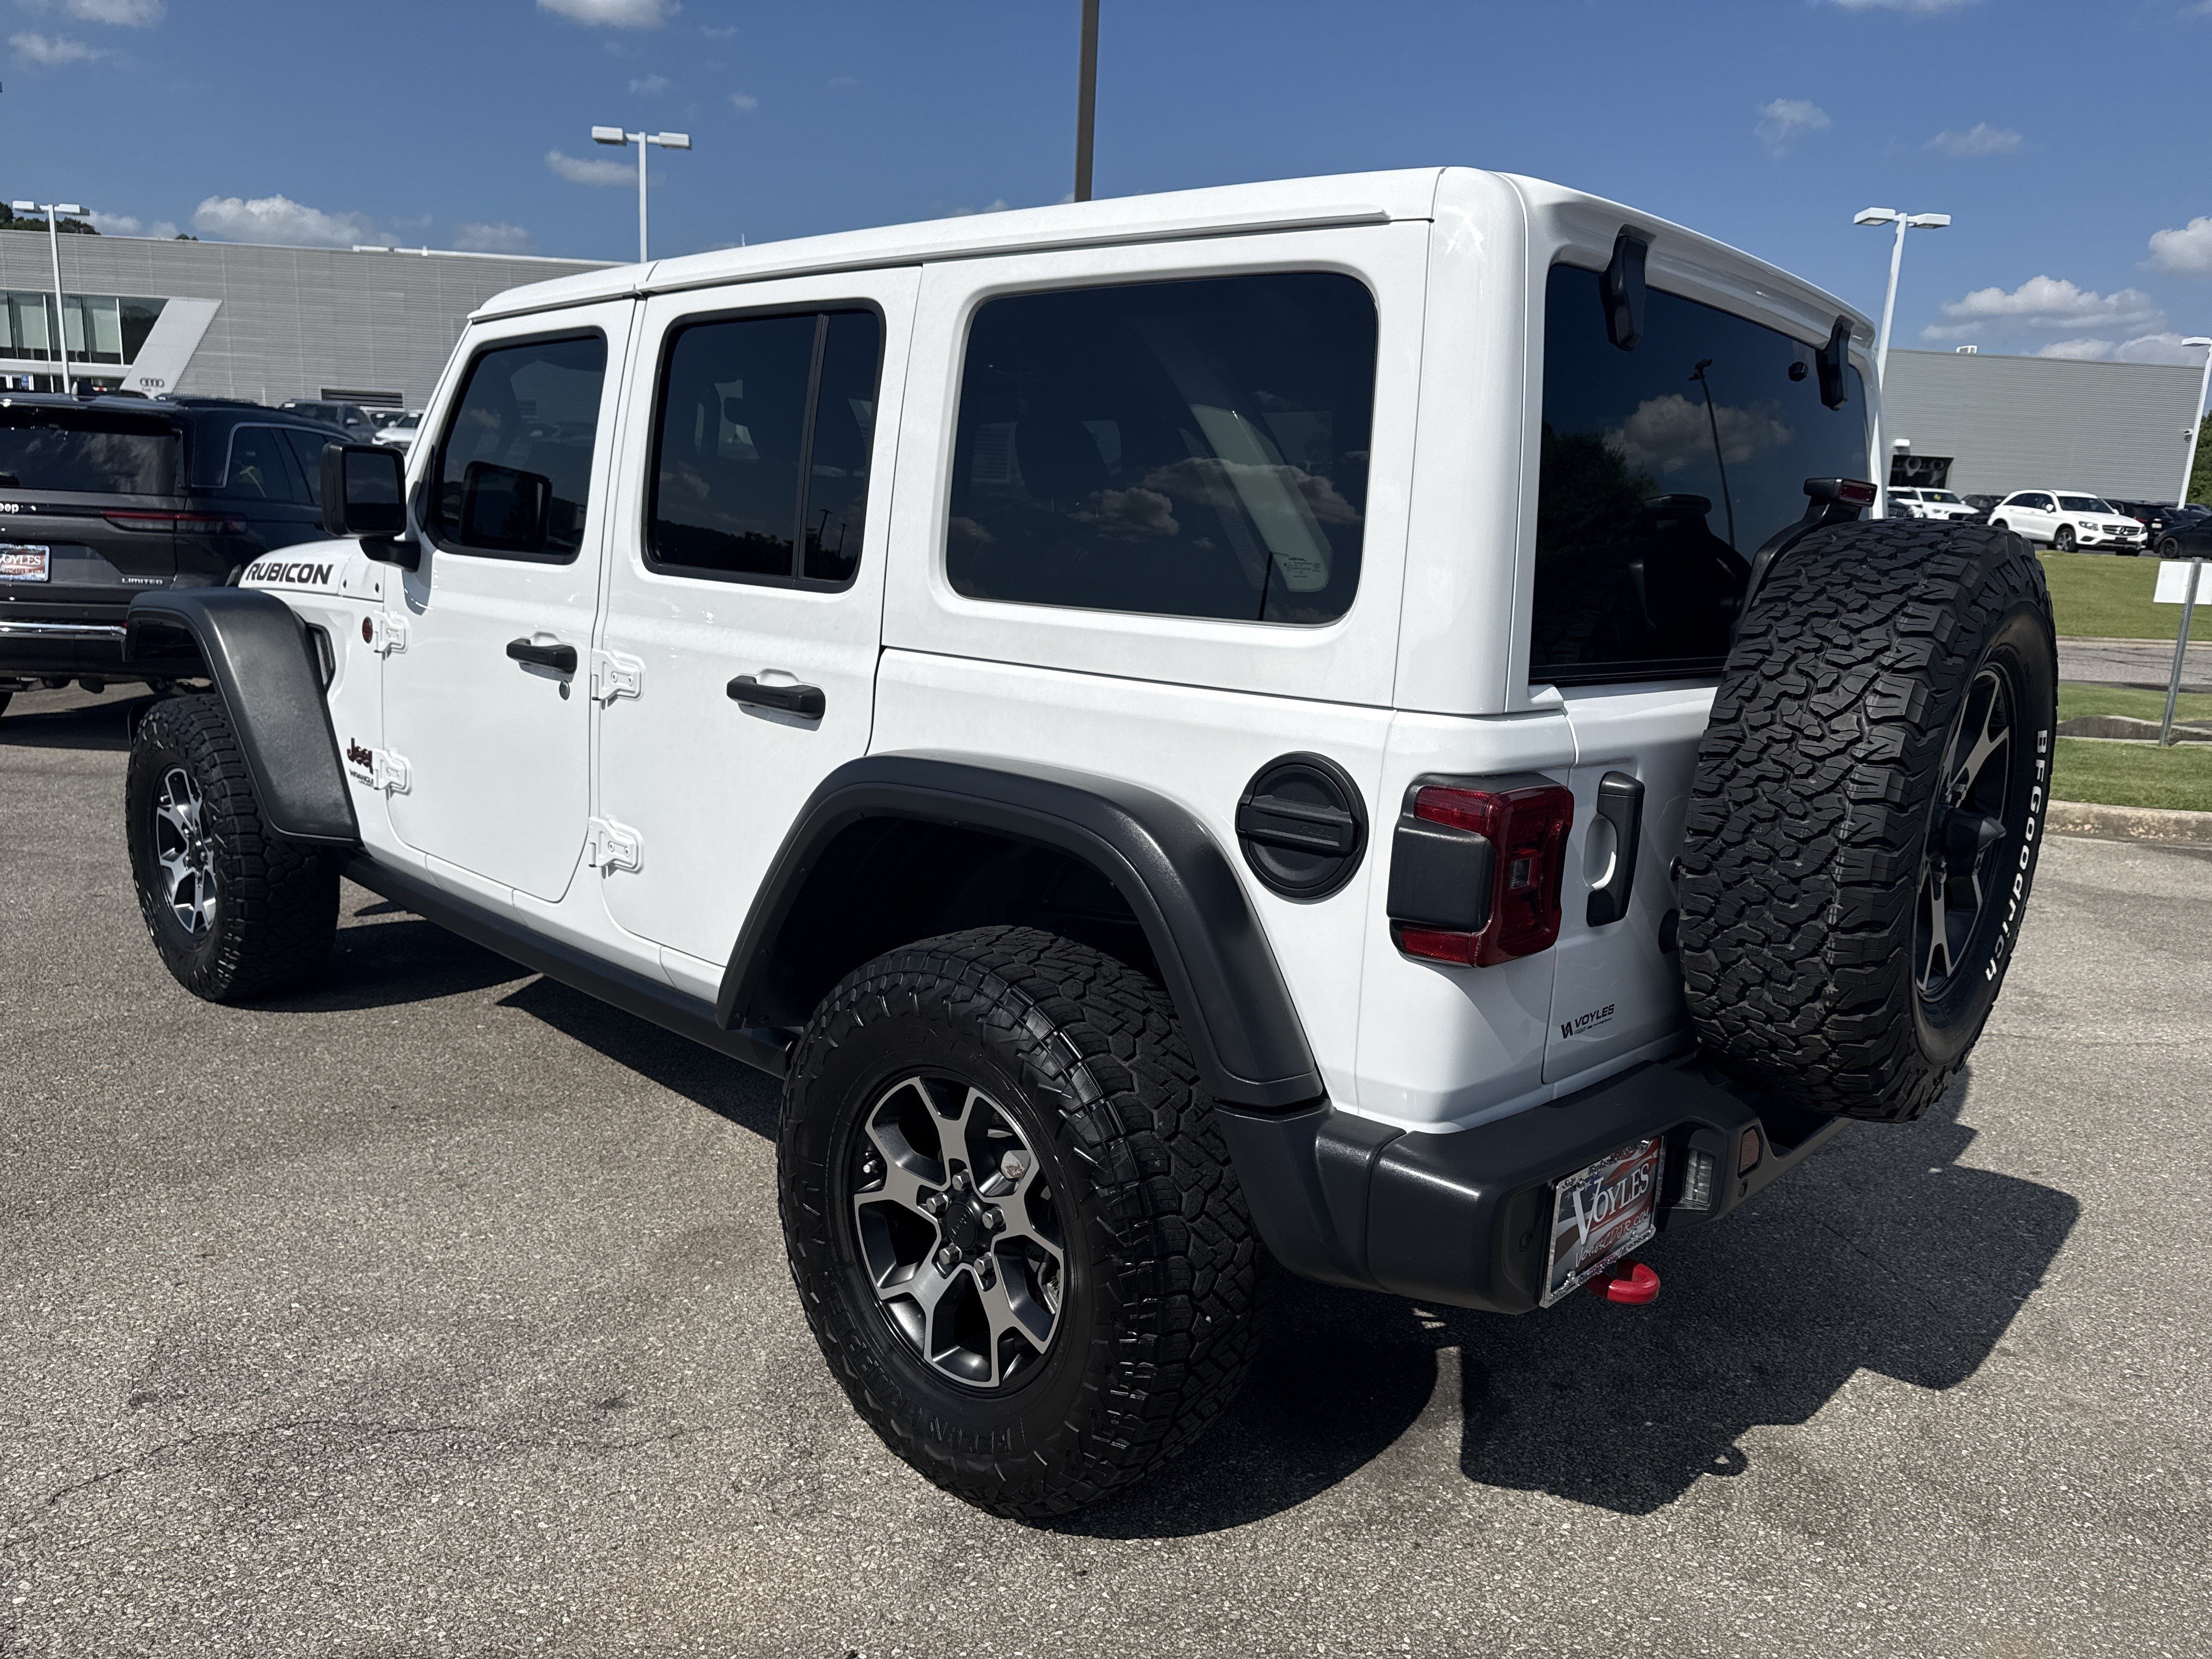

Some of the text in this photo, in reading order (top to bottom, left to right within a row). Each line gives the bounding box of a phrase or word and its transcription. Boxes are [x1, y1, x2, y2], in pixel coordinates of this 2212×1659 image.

[0, 503, 19, 514] eep
[245, 563, 334, 585] RUBICON
[1985, 730, 2047, 981] BFGoodrich
[1575, 1003, 1615, 1028] VOYLES
[1572, 1163, 1649, 1245] VOYLES
